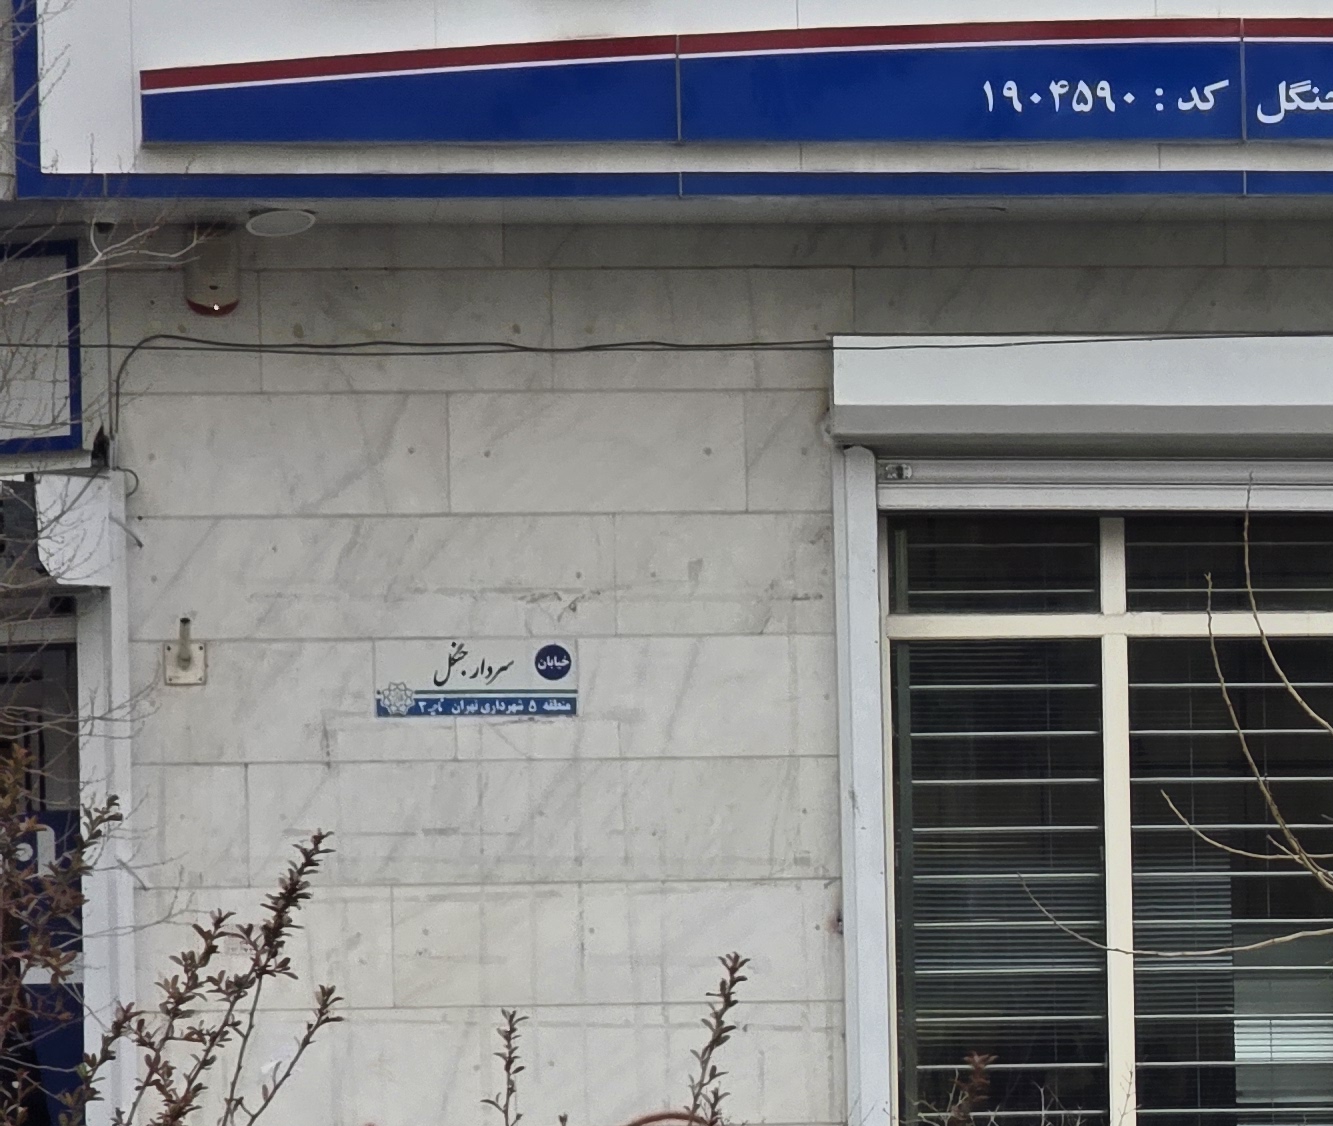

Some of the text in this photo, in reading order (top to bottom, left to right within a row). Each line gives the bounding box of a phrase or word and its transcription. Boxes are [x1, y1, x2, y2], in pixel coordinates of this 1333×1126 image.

[982, 79, 1136, 112] ۱۹۰۴۵۹۰
[1177, 79, 1230, 111] کد
[433, 641, 570, 687] خیابان سردار جنگل
[451, 699, 479, 714] تهران
[480, 699, 524, 714] شهرداری
[528, 699, 537, 712] ۵
[542, 699, 572, 711] منطقه
